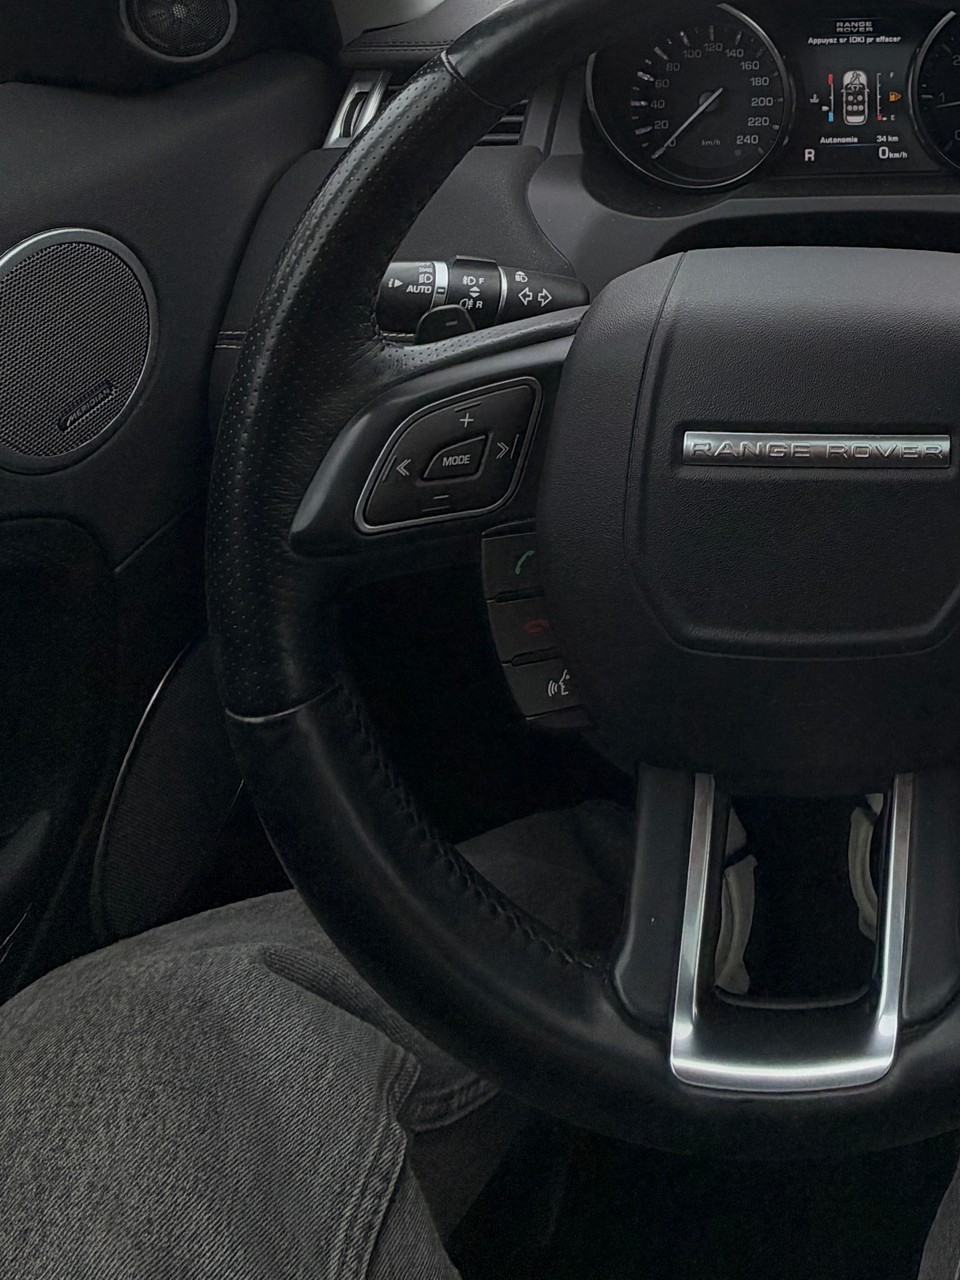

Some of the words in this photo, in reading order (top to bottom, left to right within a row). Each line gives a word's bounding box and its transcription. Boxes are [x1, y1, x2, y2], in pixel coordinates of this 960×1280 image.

[704, 43, 723, 52] 120
[682, 49, 702, 58] 100
[725, 49, 744, 58] 140
[952, 55, 960, 66] 2
[666, 62, 680, 71] 80
[740, 61, 760, 70] 160
[655, 79, 669, 88] 60
[750, 76, 769, 86] 180
[651, 100, 665, 109] 40
[751, 97, 774, 106] 200
[654, 120, 669, 129] 20
[748, 117, 770, 126] 220
[736, 135, 758, 144] 240
[804, 148, 815, 161] R
[406, 285, 432, 294] AUTO
[689, 440, 811, 458] RANGE
[826, 443, 944, 459] ROVER
[442, 454, 471, 466] MODE
